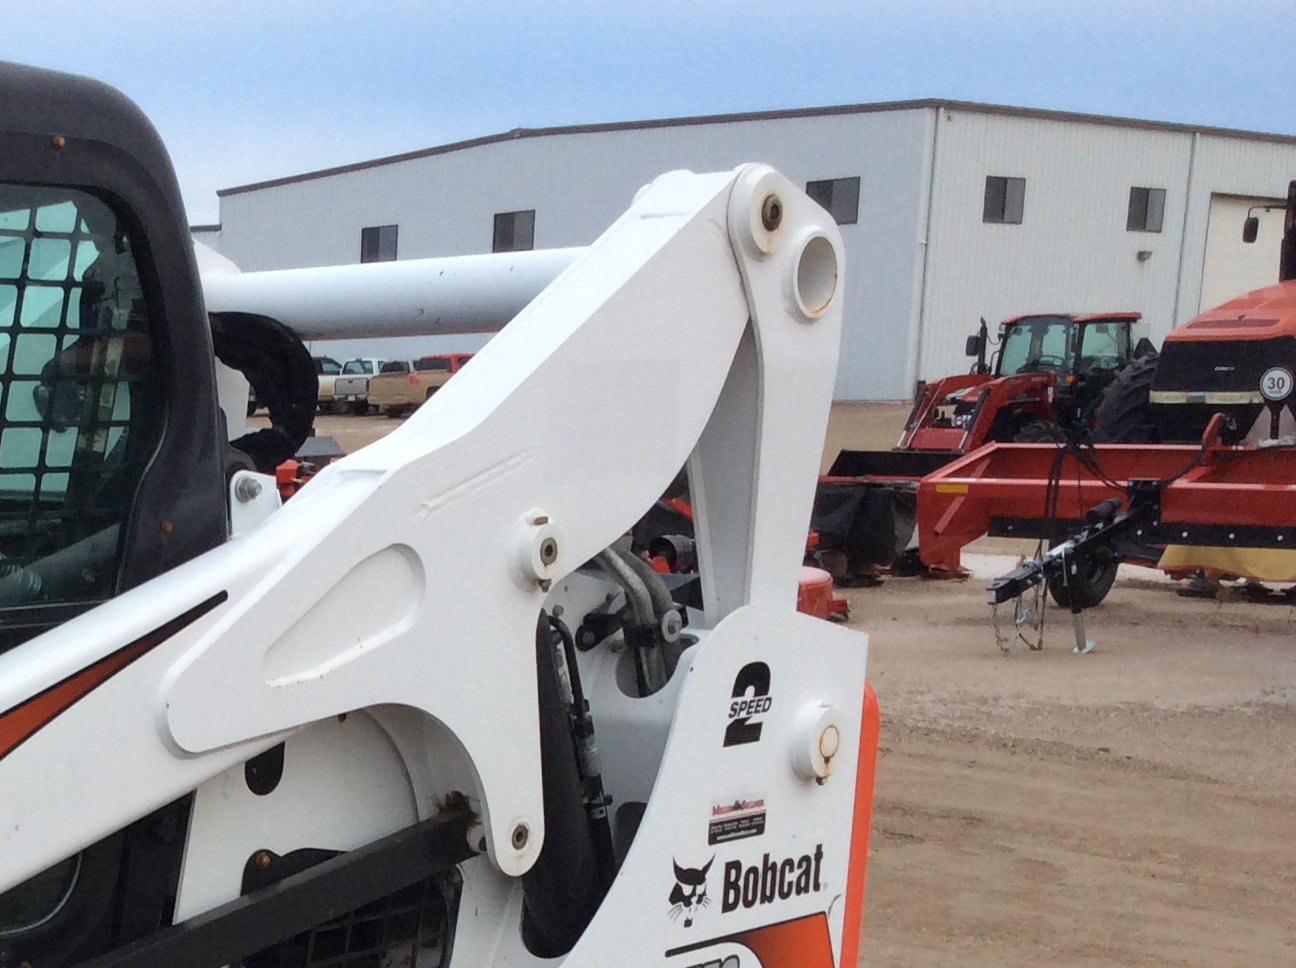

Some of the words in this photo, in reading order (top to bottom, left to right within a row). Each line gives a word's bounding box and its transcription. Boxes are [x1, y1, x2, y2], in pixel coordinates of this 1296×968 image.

[1267, 377, 1285, 390] 30
[723, 661, 771, 748] 2
[728, 697, 772, 719] SPEED
[722, 844, 823, 914] Bobcat
